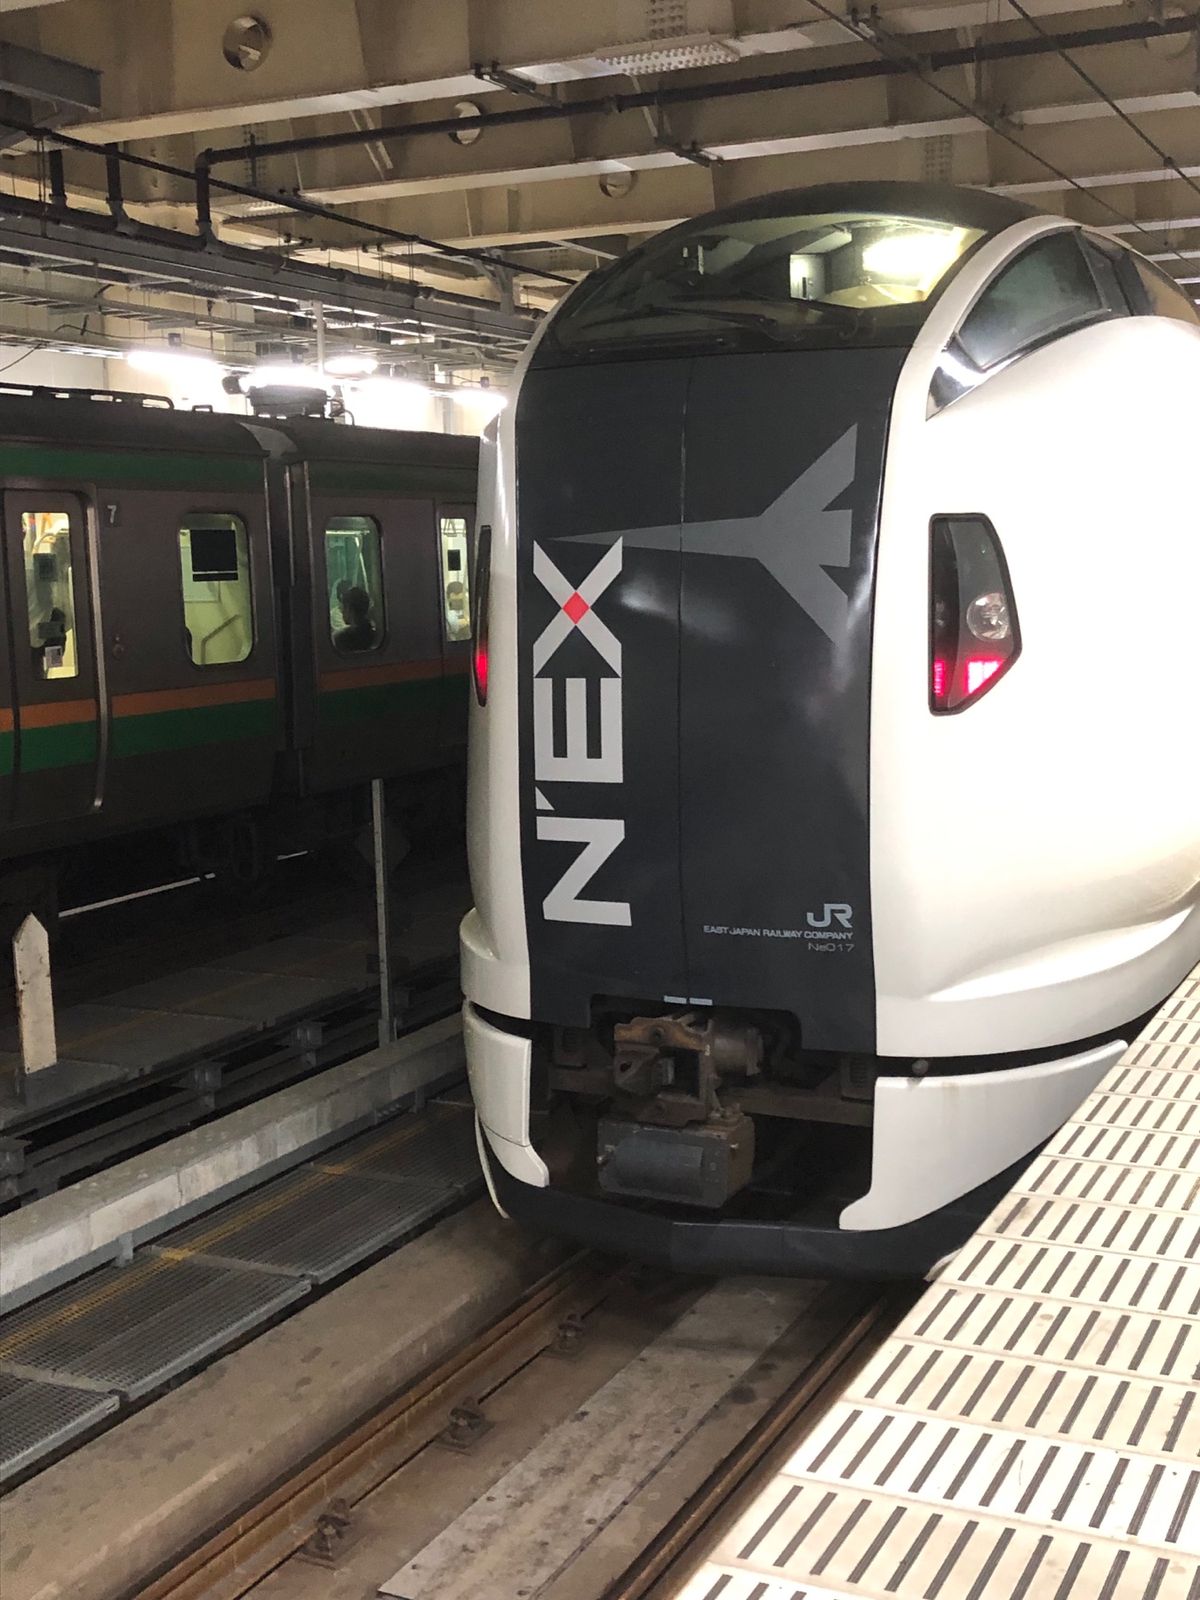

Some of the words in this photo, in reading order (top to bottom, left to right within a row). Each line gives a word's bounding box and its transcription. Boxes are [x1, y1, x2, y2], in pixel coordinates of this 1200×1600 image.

[107, 505, 117, 523] 7
[532, 535, 632, 927] N'EX
[806, 903, 853, 929] JR
[703, 925, 730, 934] EAST
[729, 927, 761, 937] JAPAN
[762, 929, 803, 938] RAILWAY
[803, 931, 853, 940] COMPANY
